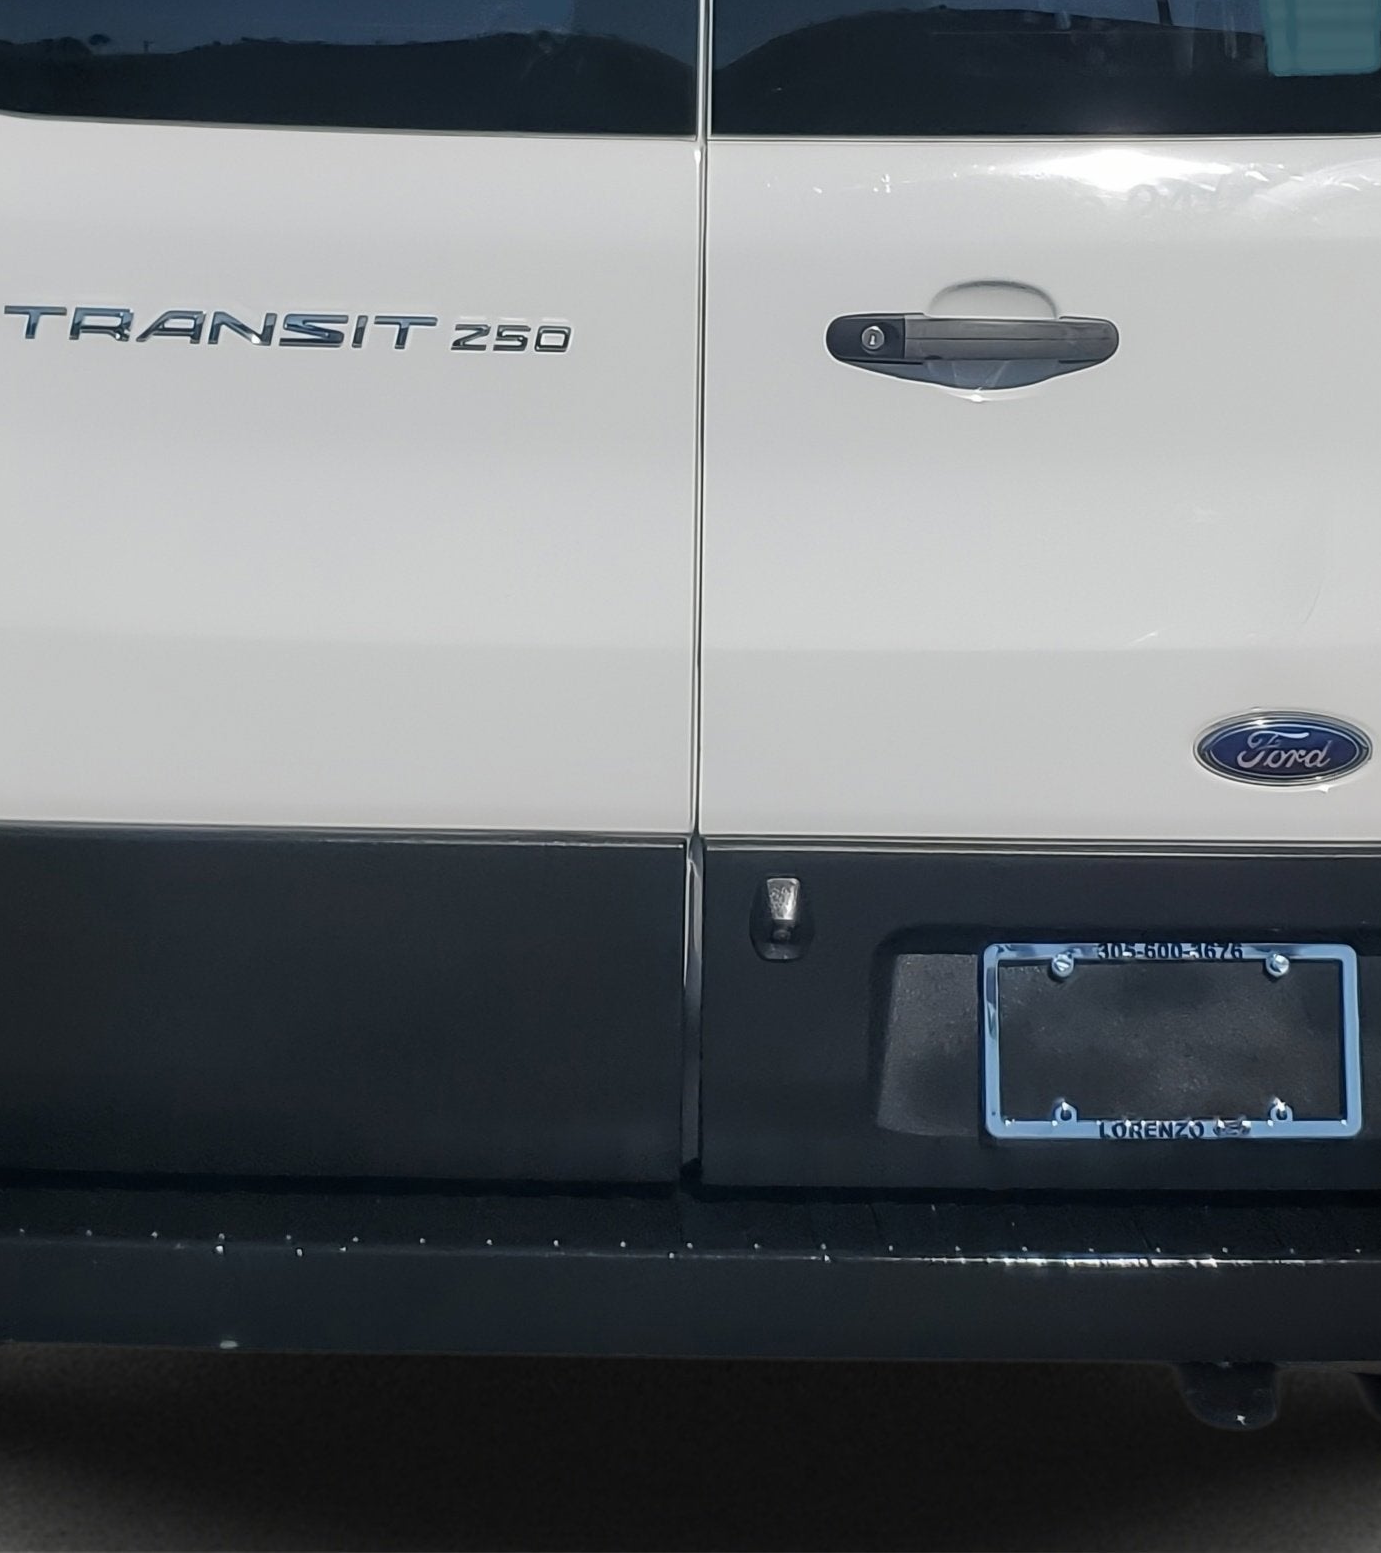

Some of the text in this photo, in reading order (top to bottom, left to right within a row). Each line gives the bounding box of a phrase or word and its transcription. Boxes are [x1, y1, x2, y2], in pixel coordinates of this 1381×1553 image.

[4, 305, 574, 353] TRANSIT 250
[1236, 730, 1332, 769] Ford
[1097, 942, 1244, 960] 305-600-3676
[1099, 1120, 1205, 1139] LORENZO
